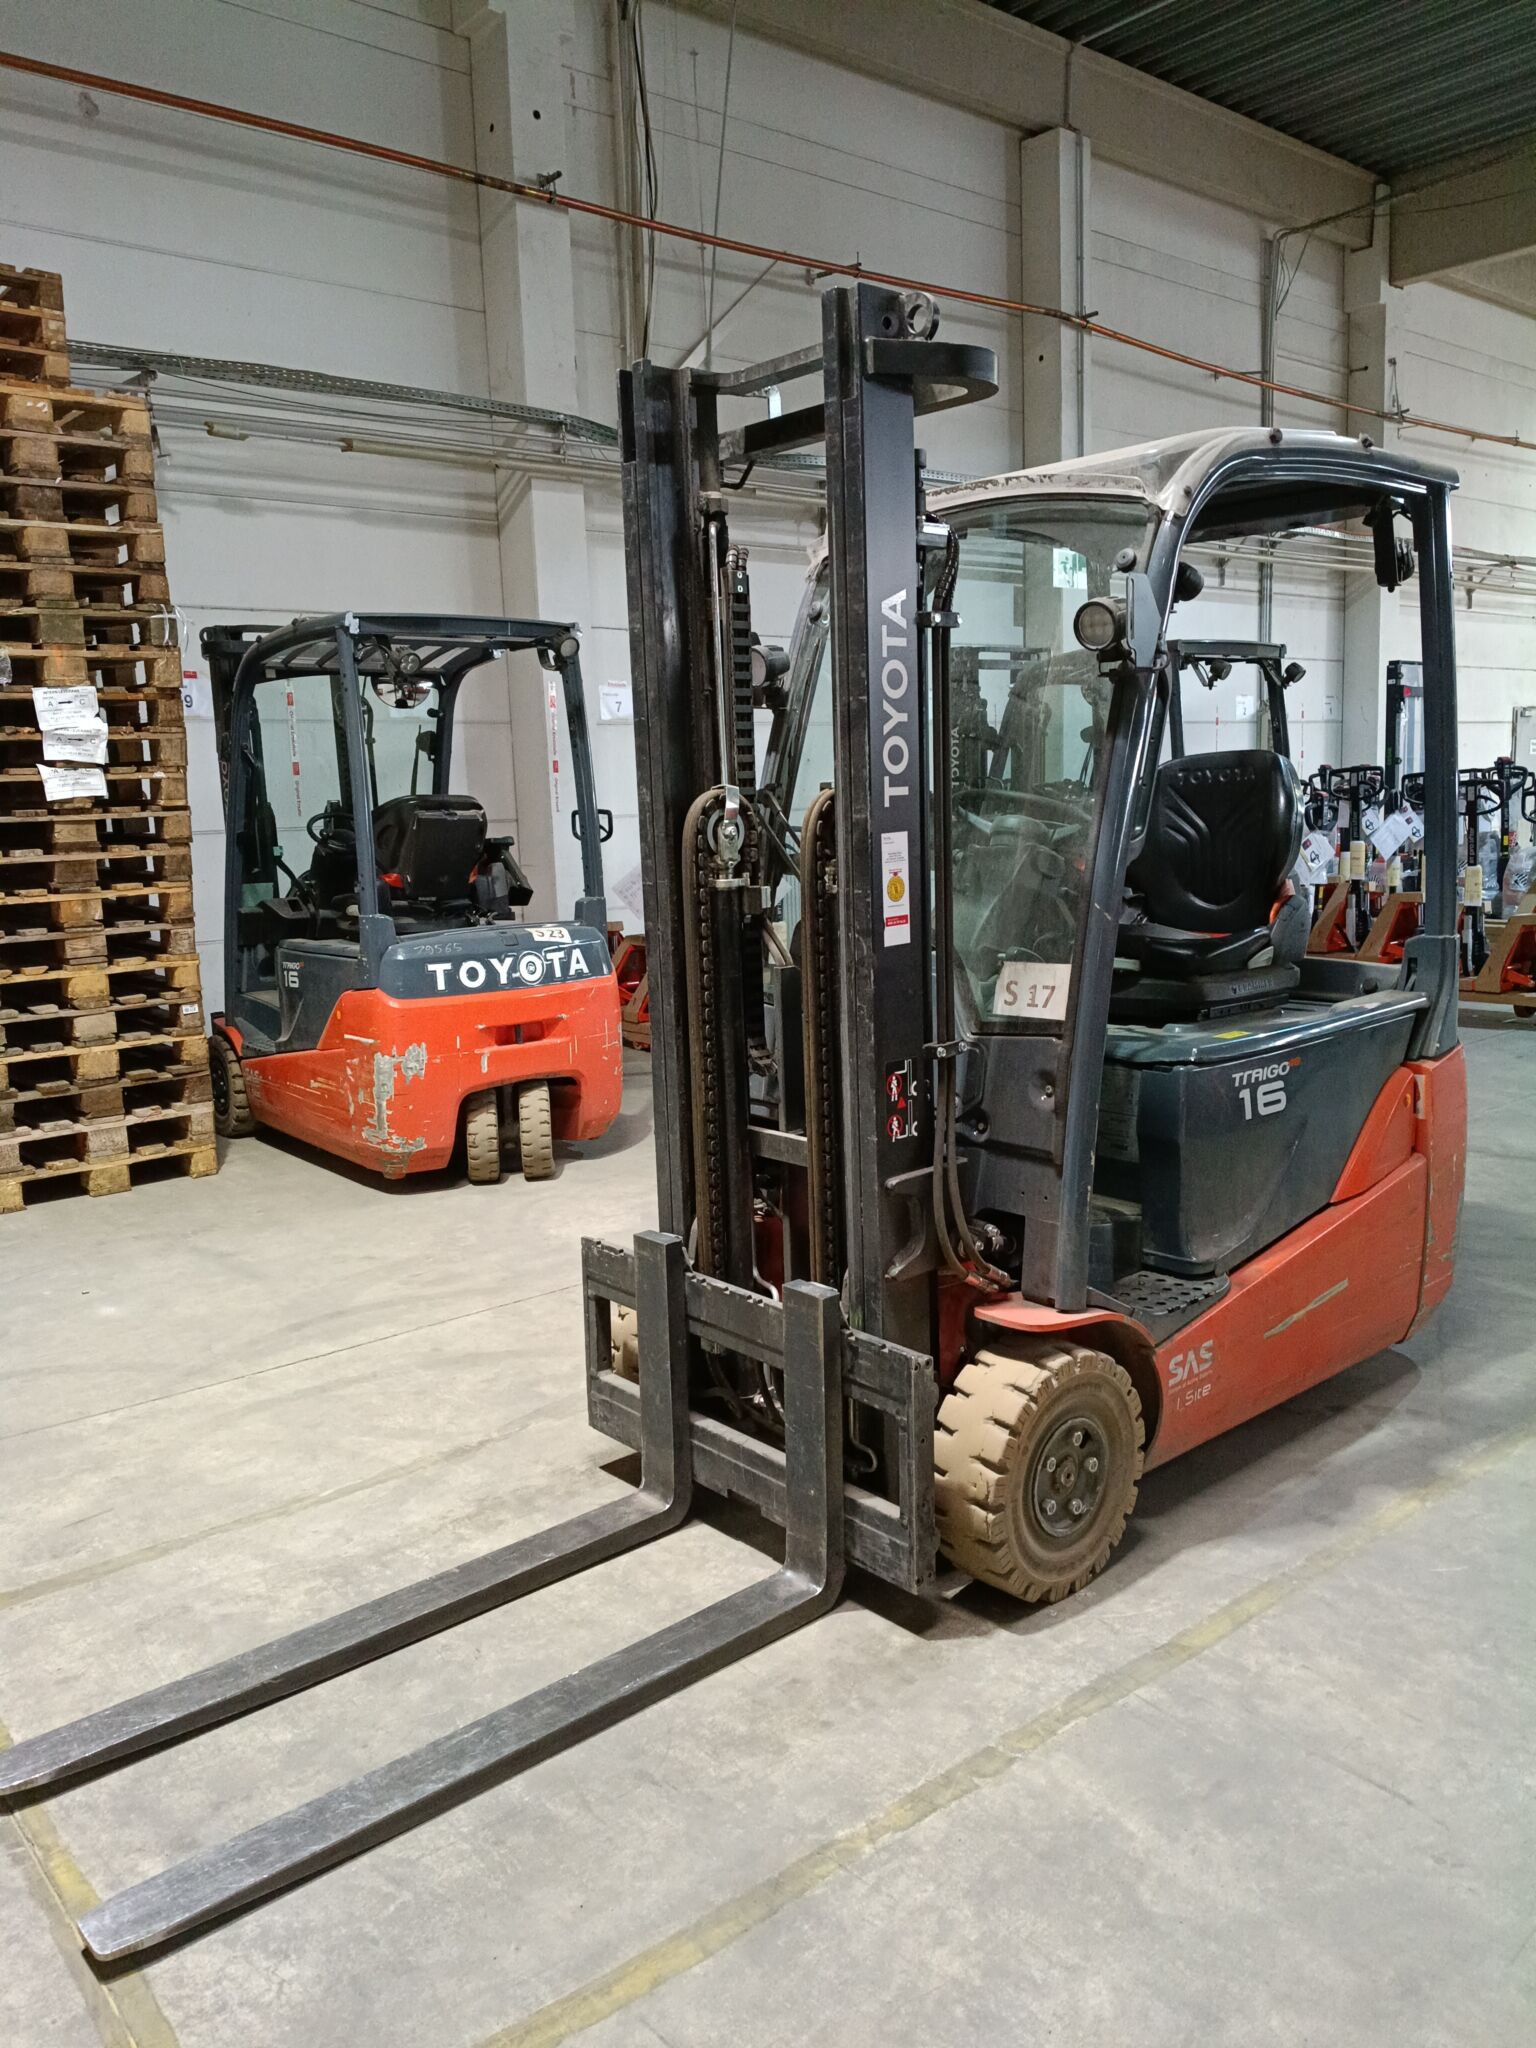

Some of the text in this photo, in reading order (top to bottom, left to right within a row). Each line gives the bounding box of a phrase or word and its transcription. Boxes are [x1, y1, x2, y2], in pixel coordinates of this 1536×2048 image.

[184, 694, 193, 708] 9
[615, 701, 622, 713] 7
[881, 588, 909, 808] TOYOTA
[950, 726, 960, 789] TOYOTA
[535, 928, 565, 939] S 23
[283, 970, 299, 988] 16
[427, 948, 590, 991] TOYOTA
[1003, 980, 1056, 1009] S 17
[1238, 1080, 1287, 1121] 16
[1168, 1339, 1214, 1387] SAS
